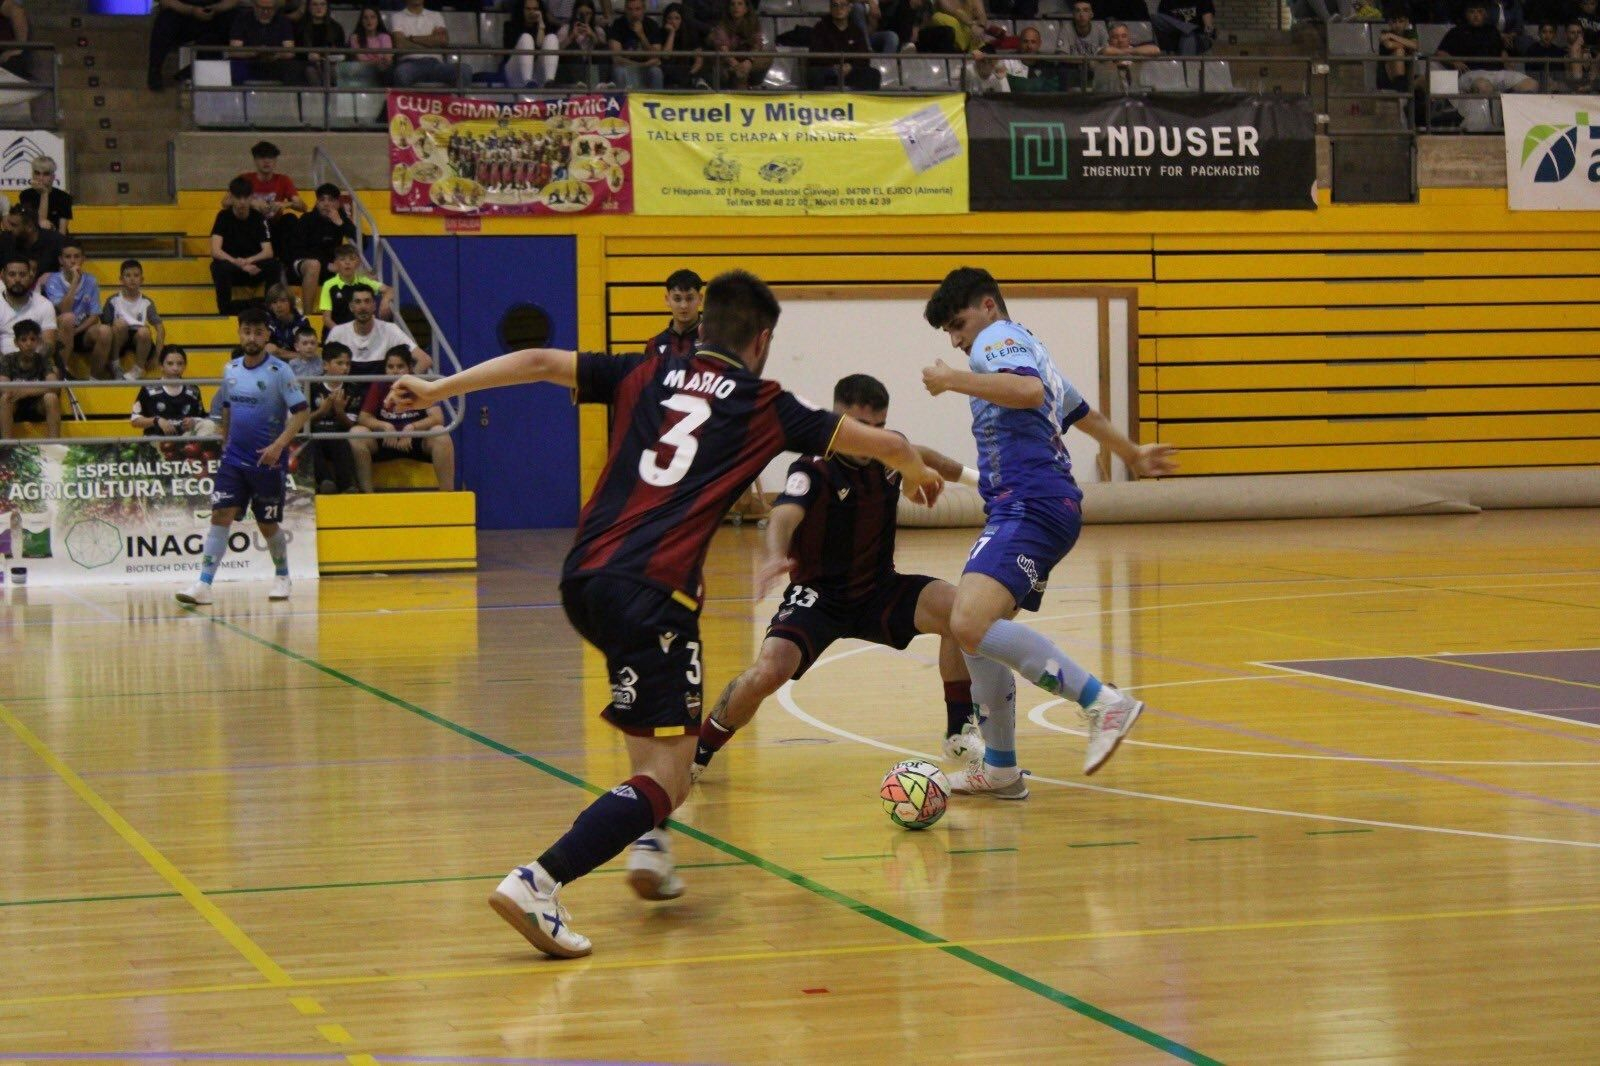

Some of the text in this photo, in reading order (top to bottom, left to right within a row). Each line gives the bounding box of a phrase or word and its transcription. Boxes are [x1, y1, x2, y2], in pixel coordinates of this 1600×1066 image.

[396, 95, 444, 115] CLUB
[447, 101, 542, 119] GIMNASIA
[642, 102, 854, 127] Teruel y Miguel
[647, 130, 858, 142] TALLER DE CHAPA Y PINTURA
[1079, 126, 1260, 157] INDUSER
[1082, 165, 1260, 177] INGENUITY FOR PACKAGING
[761, 187, 801, 196] Industrial
[873, 186, 884, 195] EL
[886, 186, 913, 195] EJIDO
[985, 351, 998, 362] EL
[999, 345, 1028, 358] EJIDO
[661, 368, 738, 400] MARIO
[639, 392, 713, 488] 3
[76, 460, 204, 479] ESPECIALISTAS
[9, 478, 167, 501] AGRICULTURA
[264, 505, 279, 520] 21
[971, 536, 992, 560] 7
[125, 560, 251, 574] BIOTECH DEVEMENT
[685, 641, 702, 685] 3
